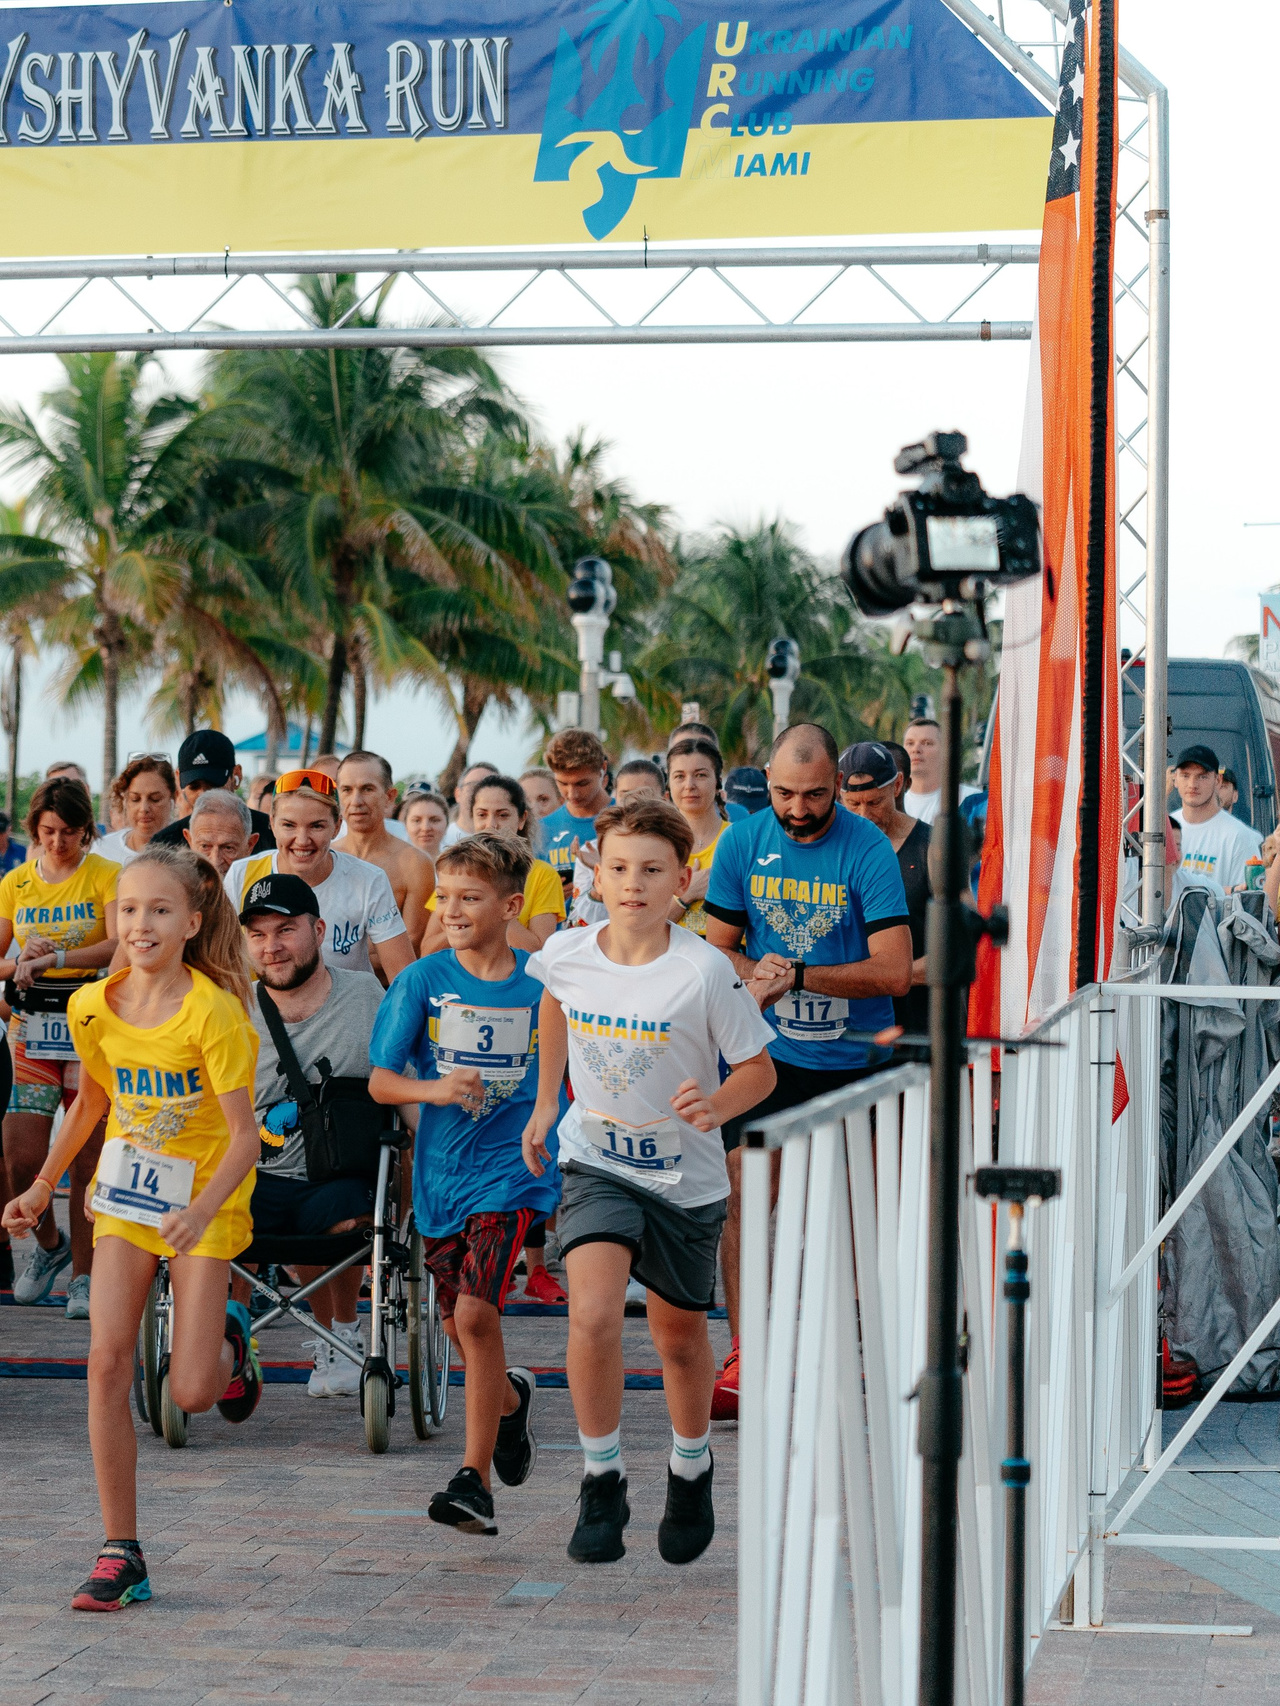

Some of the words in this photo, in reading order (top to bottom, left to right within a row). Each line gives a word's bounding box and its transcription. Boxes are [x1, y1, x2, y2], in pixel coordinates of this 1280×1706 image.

[385, 36, 509, 141] RUN
[750, 875, 847, 906] UKRAINE
[569, 1008, 671, 1042] UKRAINE
[792, 1000, 831, 1021] 117
[42, 1021, 70, 1041] 101
[477, 1025, 494, 1052] 3
[115, 1065, 203, 1097] RAINE
[605, 1131, 657, 1158] 116
[131, 1162, 159, 1195] 14
